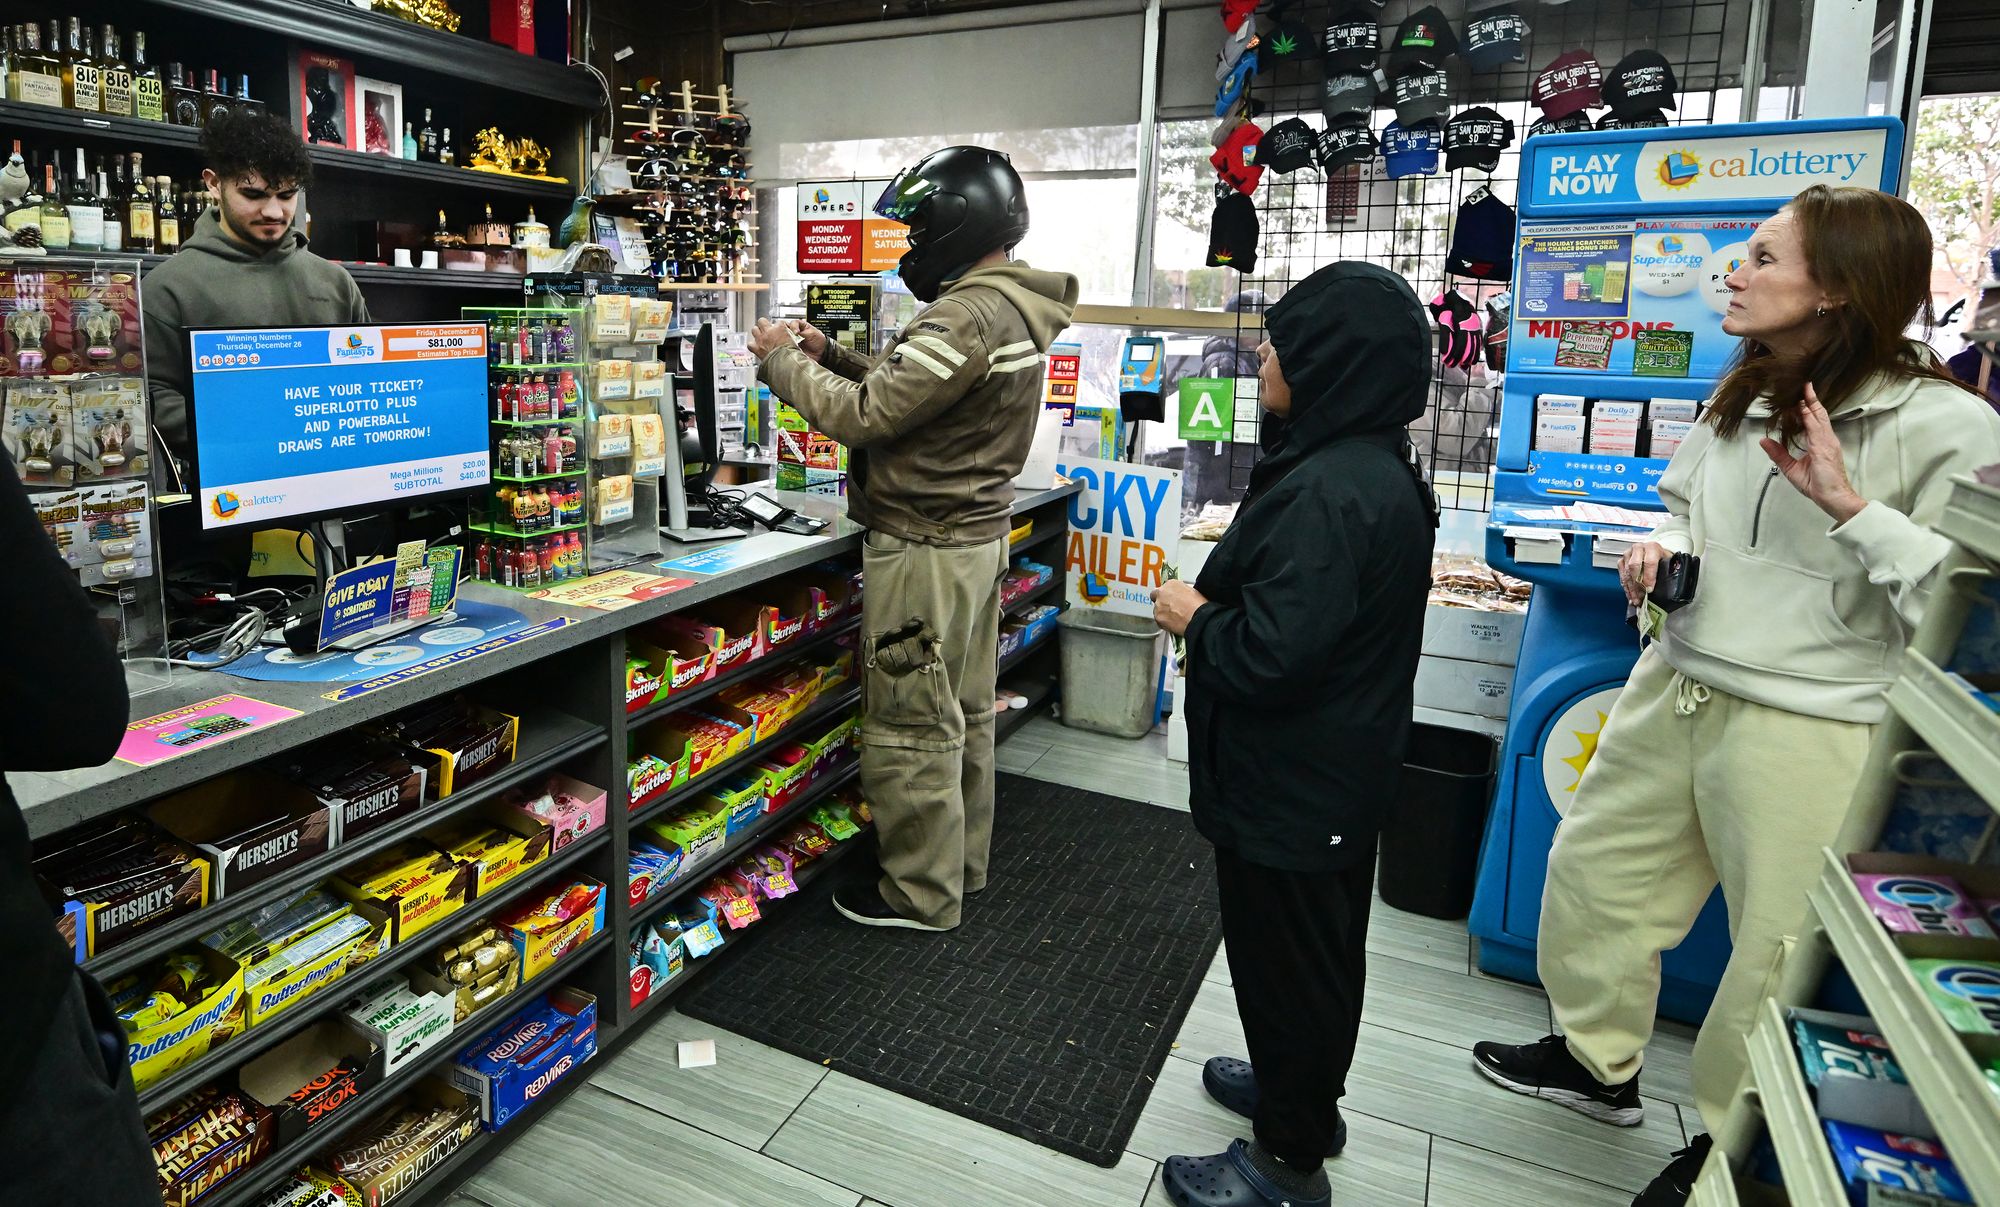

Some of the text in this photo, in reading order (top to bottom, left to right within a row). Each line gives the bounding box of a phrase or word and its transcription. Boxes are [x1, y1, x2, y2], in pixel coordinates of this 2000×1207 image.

[1337, 27, 1366, 38] SAN DIEGO
[1481, 20, 1513, 34] SAN DIEGO
[76, 67, 98, 84] 818
[106, 71, 130, 88] 818
[1409, 76, 1438, 88] SAN DIEGO
[1554, 66, 1586, 83] SAN DIEGO
[1622, 66, 1664, 79] CALIFORNIA
[139, 79, 160, 94] 818
[1627, 84, 1662, 97] REPUBLIC
[1397, 130, 1428, 141] SAN DIEGO
[1459, 125, 1490, 134] SAN DIEGO
[1542, 119, 1576, 134] SAN DIEGO
[1327, 133, 1338, 144] SAN
[1552, 154, 1621, 174] PLAY
[1710, 148, 1866, 180] calottery
[1549, 174, 1618, 196] NOW
[812, 226, 844, 234] MONDAY
[871, 229, 910, 238] WEDNES
[875, 240, 910, 248] SATURD
[524, 286, 534, 295] blu
[216, 340, 302, 352] Thursday, December 26
[226, 333, 292, 343] Winning Numbers
[428, 338, 463, 348] $81,000
[1566, 332, 1606, 344] PEPPERMINT
[1576, 342, 1604, 352] PAYOUT
[238, 356, 248, 364] 28
[417, 350, 448, 358] Estimated
[285, 380, 424, 400] HAVE YOUR TICKET?
[294, 396, 417, 417] SUPERLOTTO PLUS
[1188, 392, 1222, 428] A
[304, 413, 410, 434] AND POWERBALL
[278, 426, 432, 454] DRAWS ARE TOMORROW!
[390, 460, 486, 480] Mega Millions $20.00
[394, 470, 486, 491] SUBTOTAL $40.00
[328, 585, 355, 608] GIVE
[343, 599, 376, 618] SCRATCHERS
[770, 622, 802, 644] Skittles
[717, 637, 752, 665] Skittles
[362, 676, 400, 690] GIVE
[402, 665, 428, 680] THE
[672, 664, 706, 688] Skittles
[626, 680, 660, 704] Skittles
[178, 697, 236, 716] WORLD
[460, 736, 498, 772] HERSHEY'S
[822, 733, 846, 758] PUNCH
[630, 770, 672, 803] Skittles
[784, 771, 808, 790] PUNCH
[346, 785, 399, 824] HERSHEY'S
[732, 794, 758, 816] PUNCH
[690, 826, 720, 853] PUNCH
[238, 829, 298, 872] HERSHEY'S
[486, 857, 508, 874] HERSHEY'S
[768, 874, 784, 886] RIP
[101, 884, 174, 932] HERSHEY'S
[402, 892, 428, 913] HERSHEY'S
[732, 898, 748, 910] RIP
[258, 956, 343, 1015] Butterfinger
[128, 988, 236, 1066] Butterfinger
[396, 1014, 444, 1050] Junior
[422, 1016, 451, 1041] Mints
[290, 1064, 350, 1102] SKOR
[306, 1081, 359, 1122] SKOR
[158, 1123, 242, 1183] HEATH
[181, 1143, 252, 1207] HEATH
[380, 1128, 460, 1207] BIG HUNK
